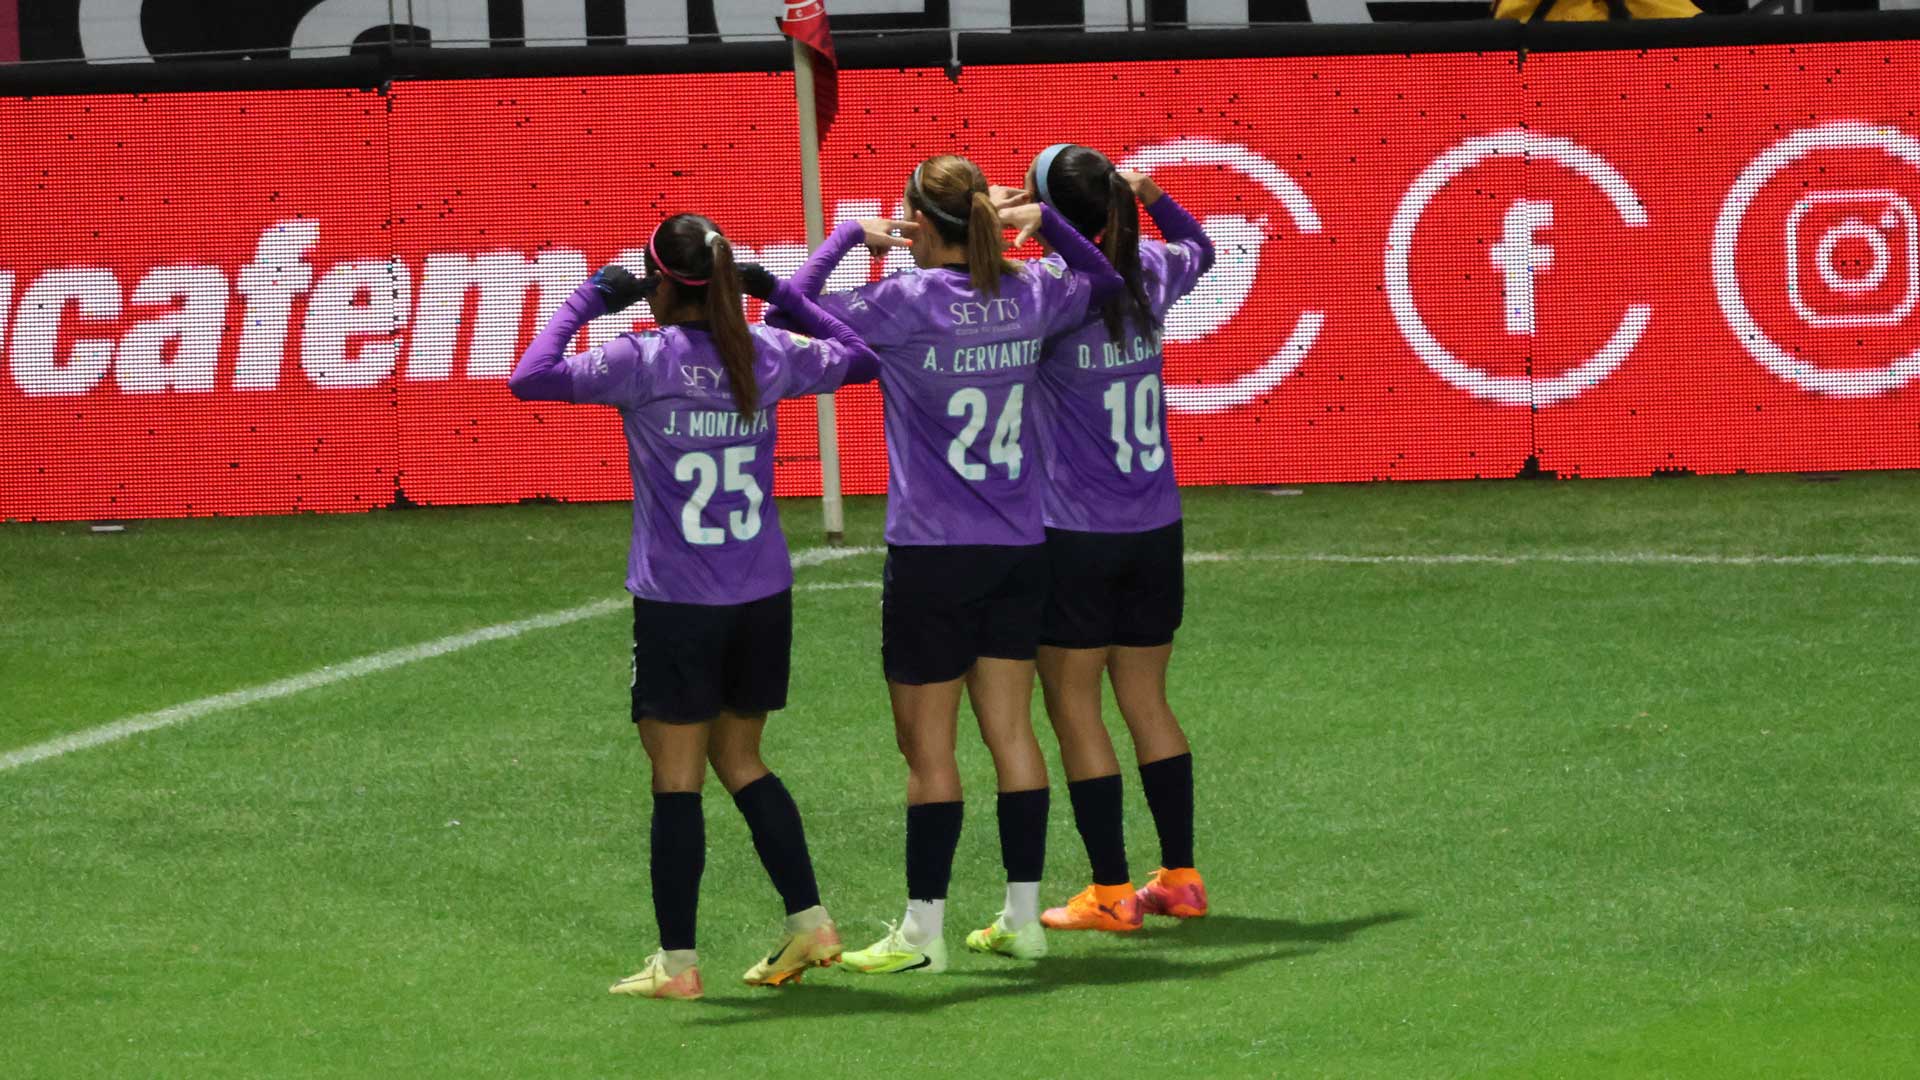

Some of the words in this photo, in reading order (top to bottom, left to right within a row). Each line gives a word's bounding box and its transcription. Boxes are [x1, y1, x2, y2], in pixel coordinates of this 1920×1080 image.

[923, 346, 944, 371] A.
[953, 338, 1041, 372] CERVANTE
[1079, 344, 1097, 368] D.
[663, 411, 681, 434] J.
[947, 383, 1025, 481] 24
[1104, 373, 1165, 473] 19
[674, 446, 764, 545] 25
